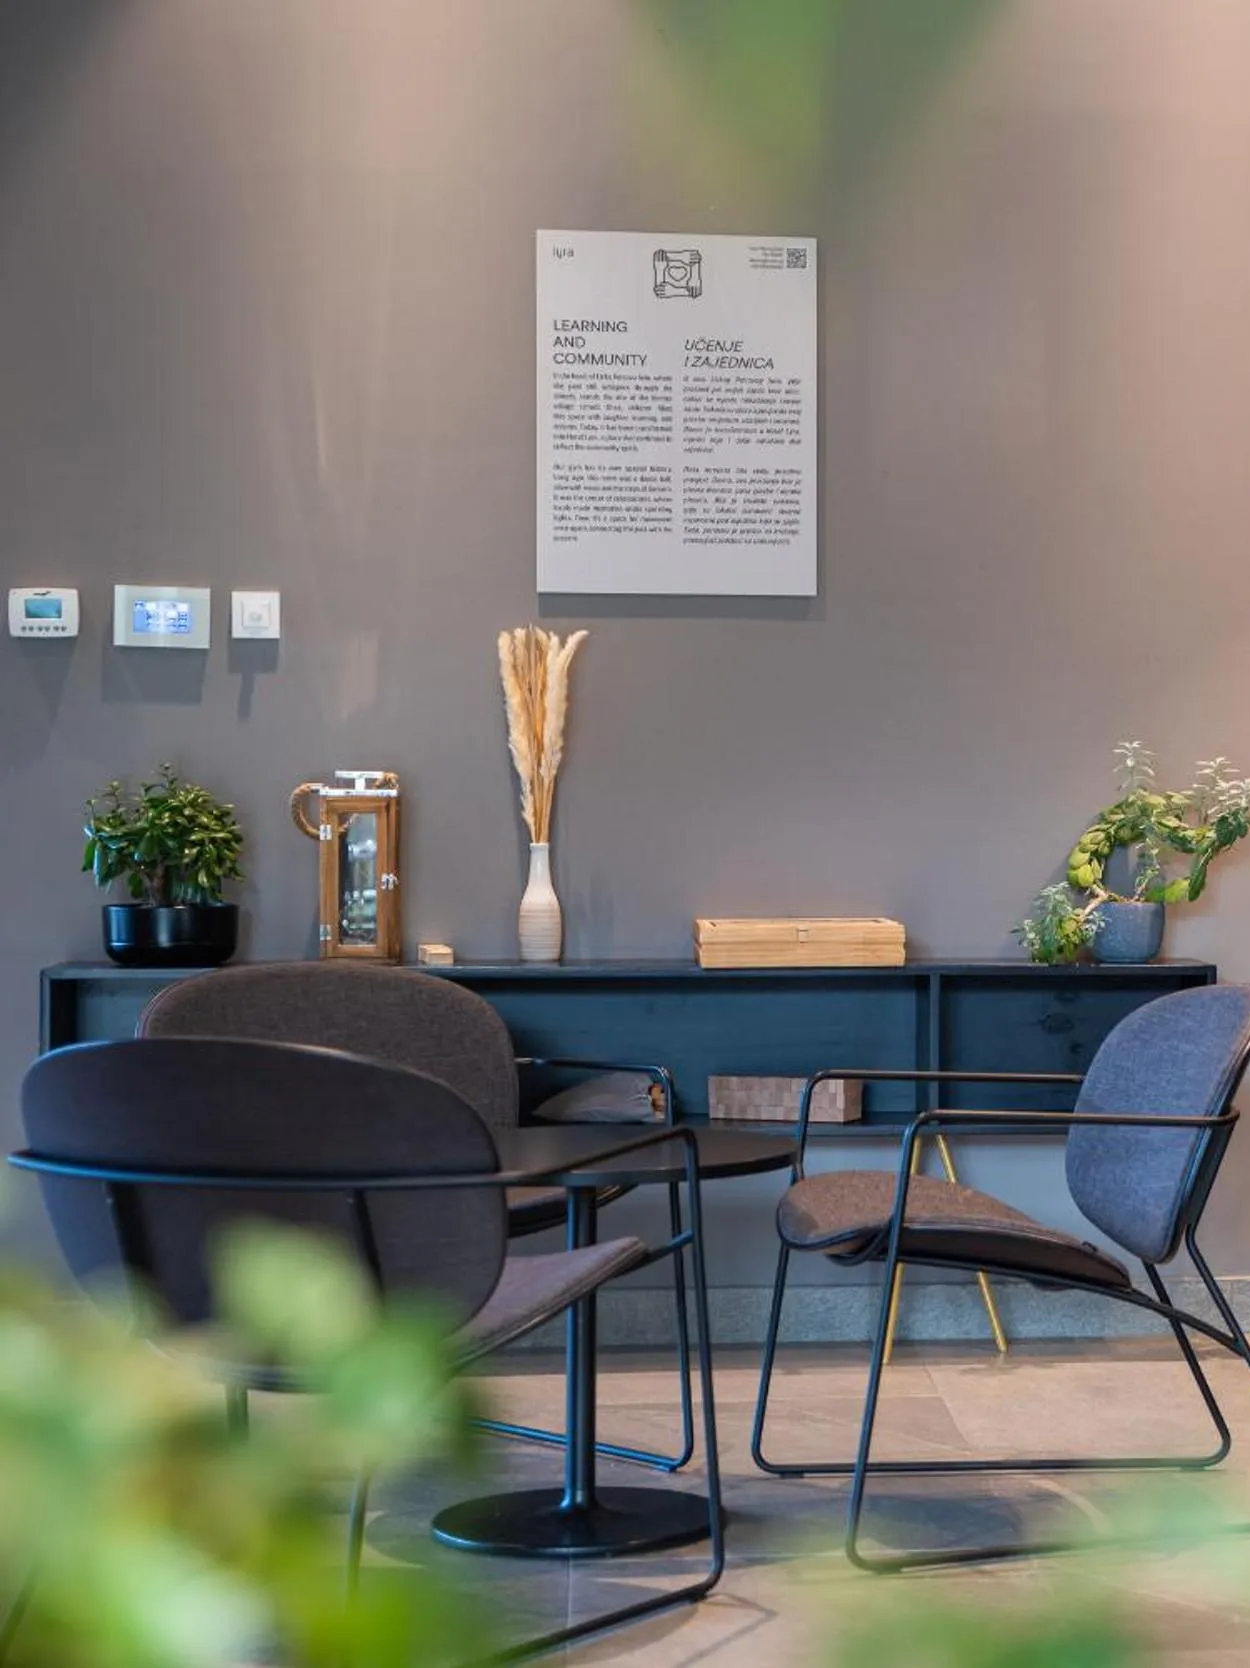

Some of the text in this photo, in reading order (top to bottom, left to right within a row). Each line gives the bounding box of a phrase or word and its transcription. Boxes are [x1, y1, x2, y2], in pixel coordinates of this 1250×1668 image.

[553, 319, 628, 333] LEARNING
[552, 335, 587, 349] AND
[684, 336, 744, 353] UČENJE
[552, 352, 648, 368] COMMUNITY
[683, 355, 774, 371] I ZAJEDNICA
